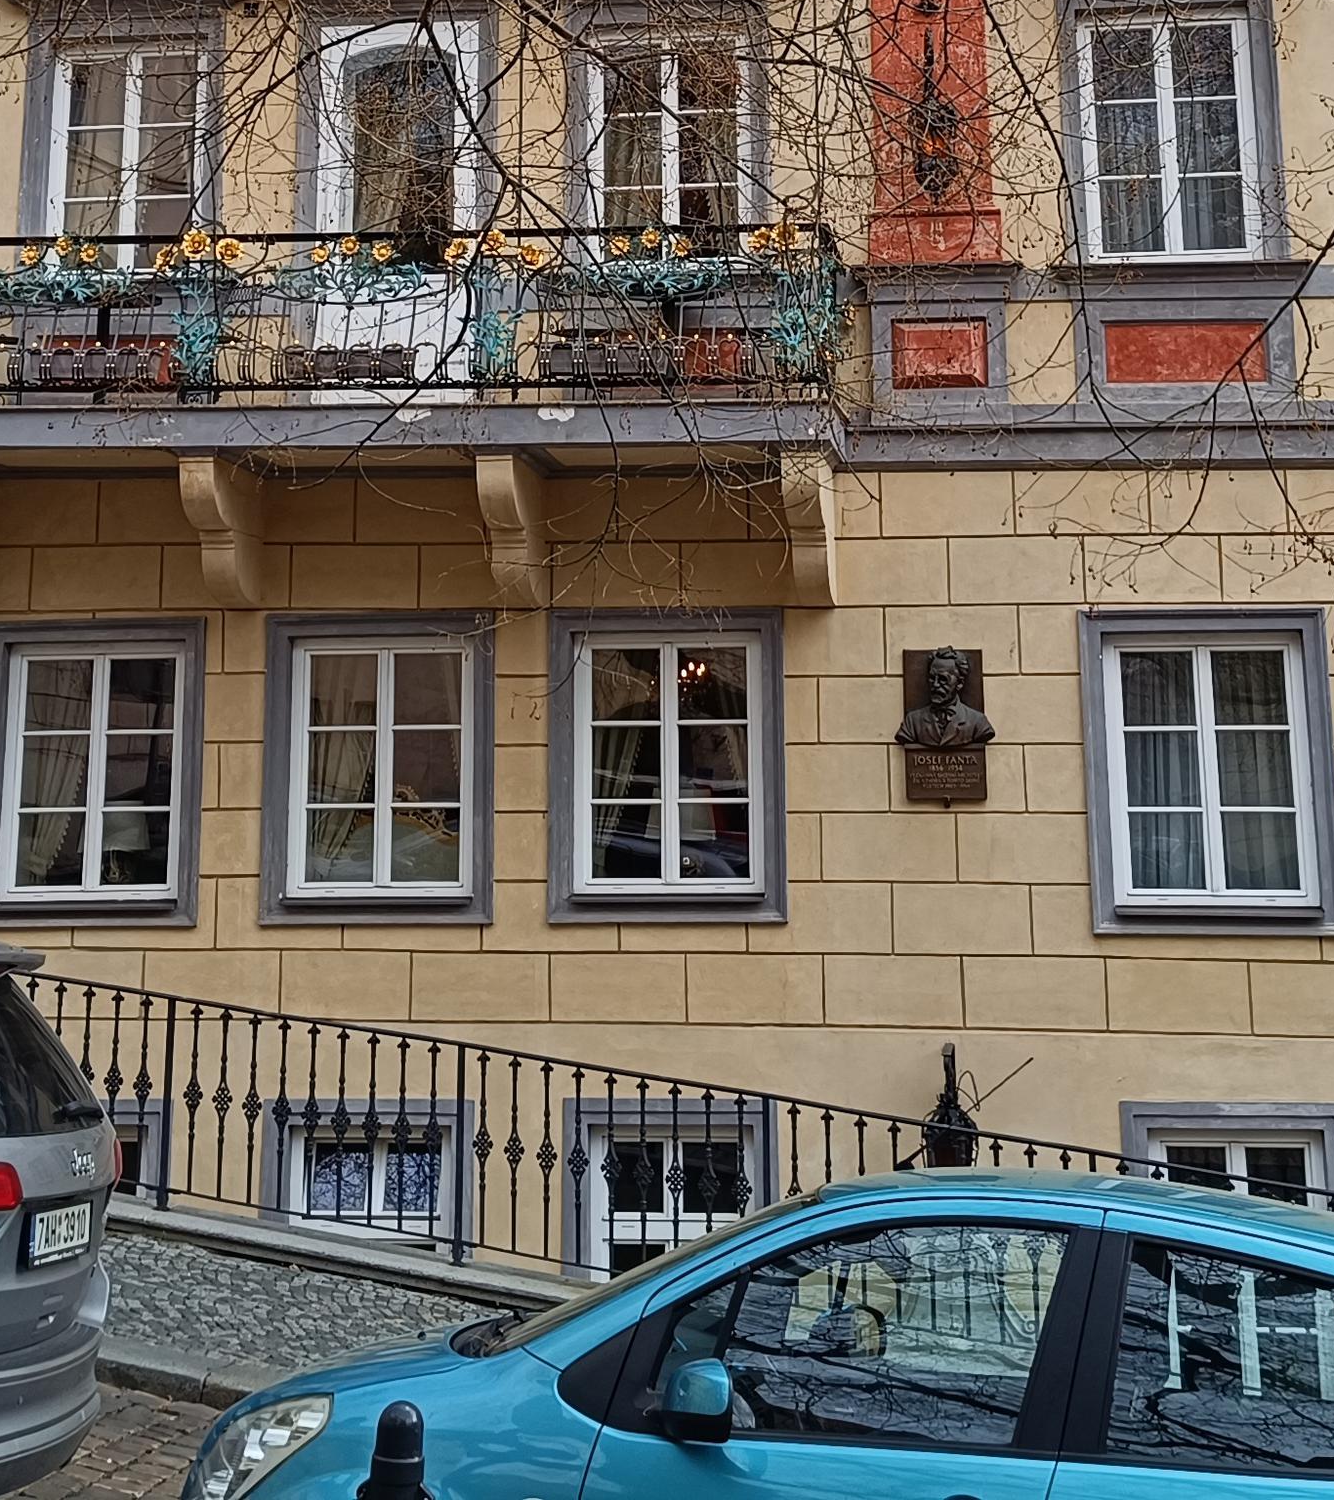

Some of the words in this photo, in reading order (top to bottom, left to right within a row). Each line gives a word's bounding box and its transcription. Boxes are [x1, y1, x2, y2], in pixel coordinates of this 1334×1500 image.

[70, 1148, 96, 1181] Jeep
[37, 1213, 58, 1251] 7AH
[63, 1208, 87, 1245] 3910
